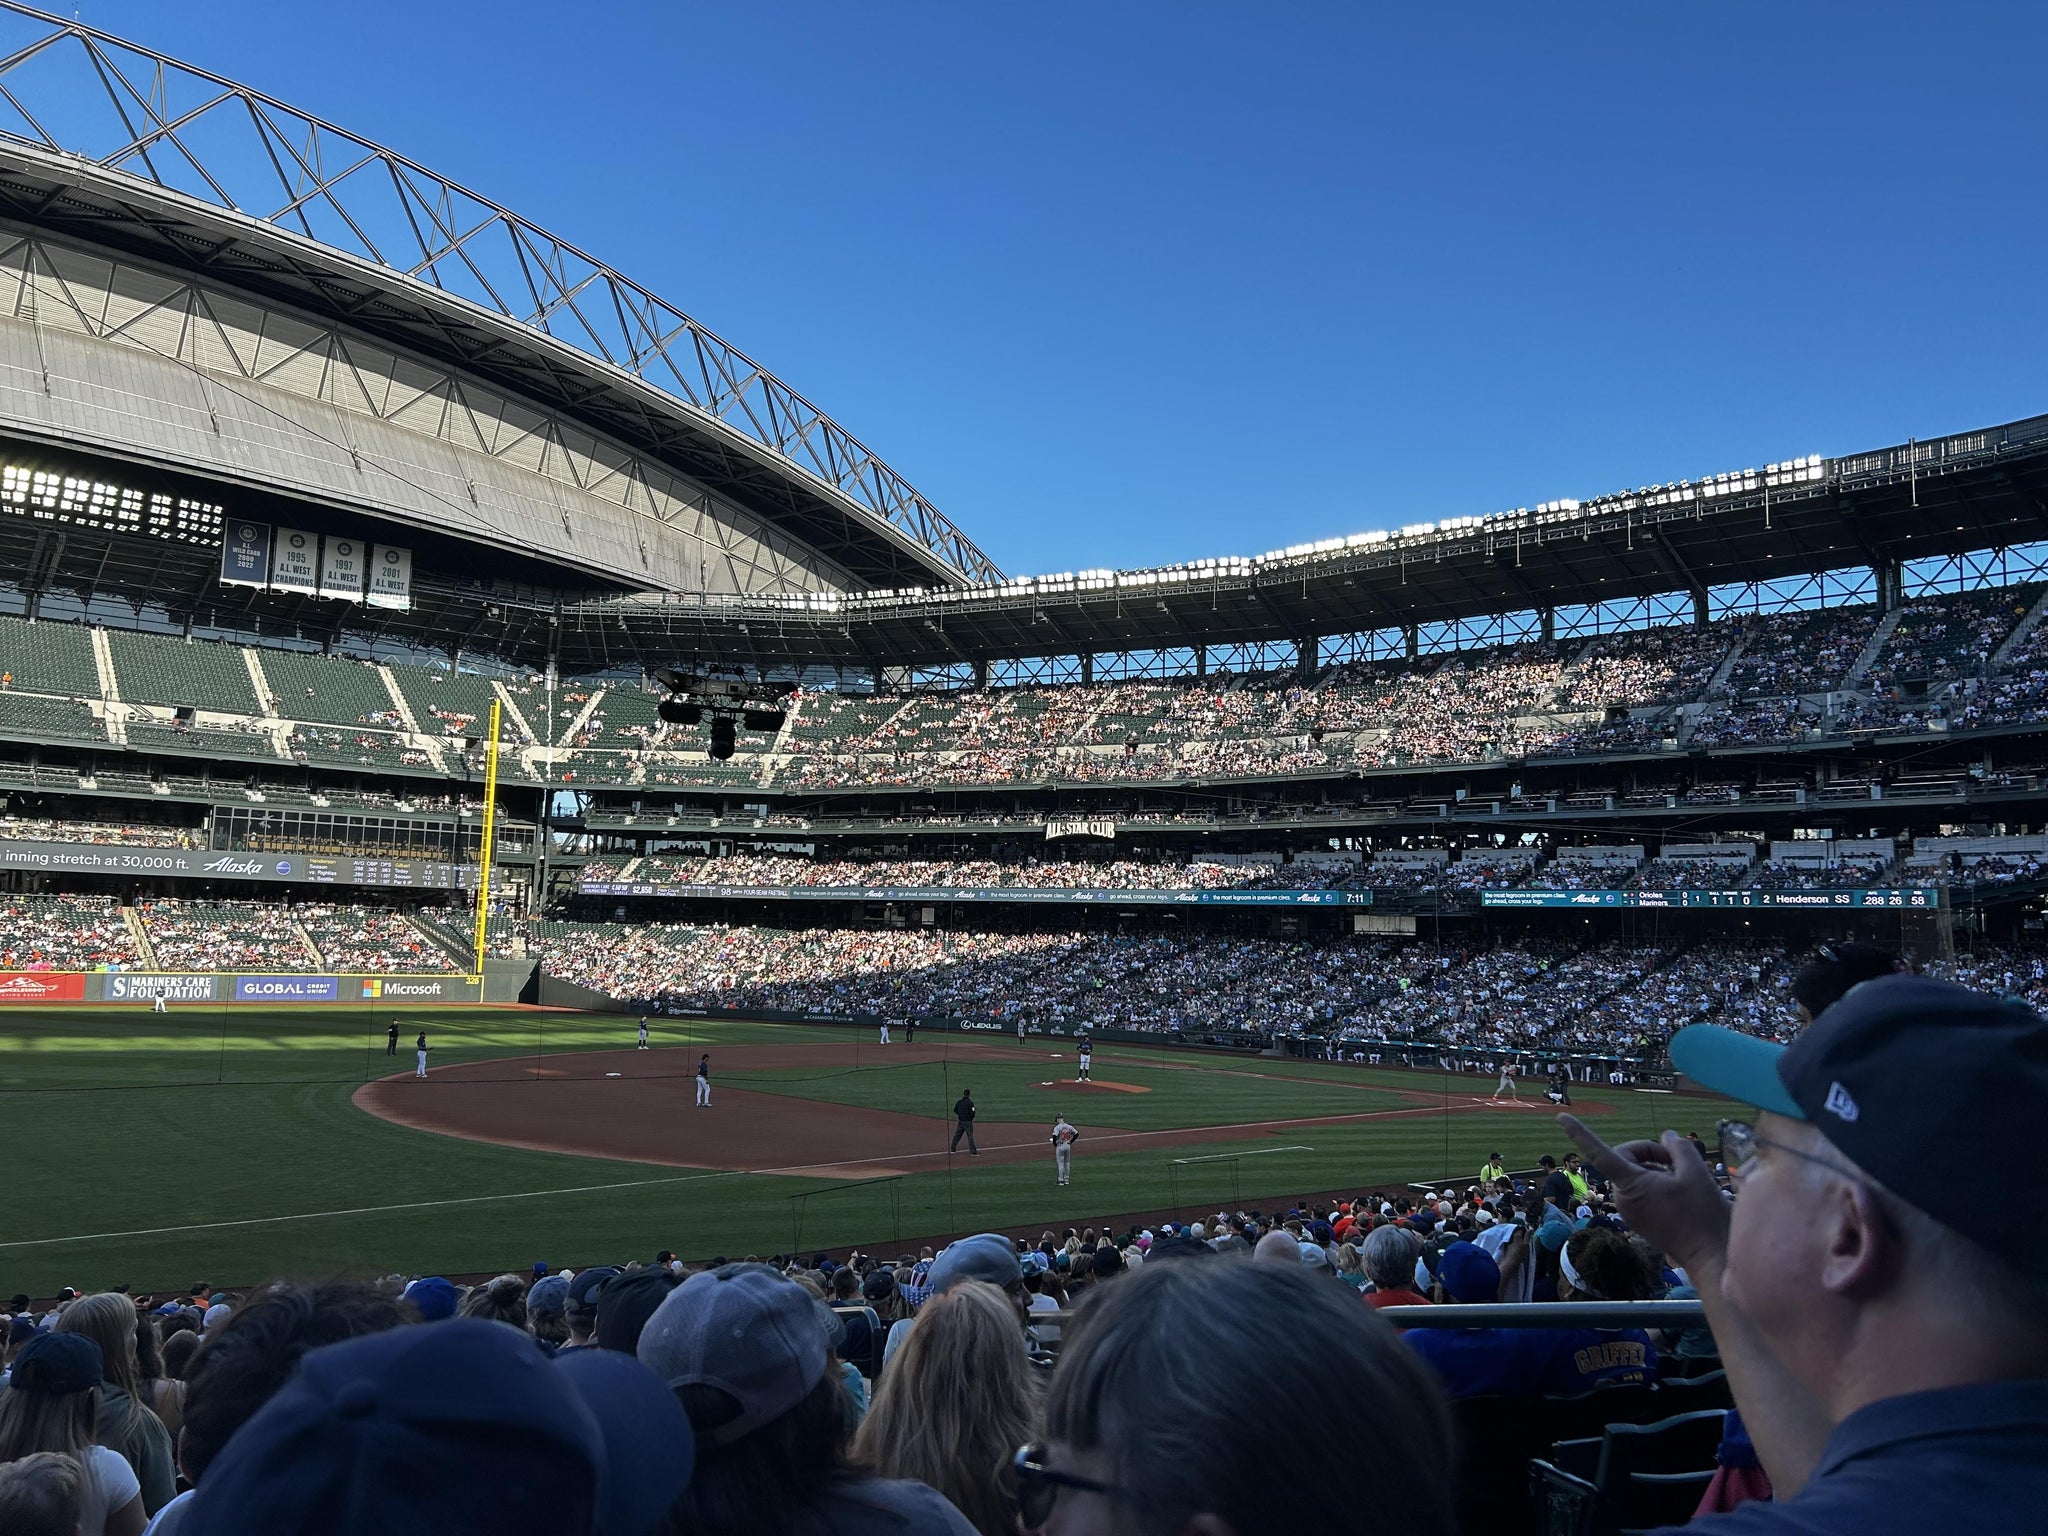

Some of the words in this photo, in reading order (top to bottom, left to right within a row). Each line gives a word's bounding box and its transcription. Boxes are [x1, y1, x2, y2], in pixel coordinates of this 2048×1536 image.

[287, 552, 306, 563] 1995
[237, 560, 254, 568] 2022
[280, 563, 291, 573] A.L.
[293, 565, 311, 575] WEST
[335, 559, 353, 571] 1997
[328, 571, 339, 580] A.L.
[340, 572, 358, 583] WEST
[382, 567, 400, 578] 2001
[275, 574, 313, 587] CHAMPIONS
[376, 578, 386, 587] A.L.
[388, 580, 405, 590] WEST
[324, 581, 361, 593] CHAMPIONS
[1045, 822, 1063, 840] ALL
[1066, 822, 1090, 834] STAR
[1090, 822, 1115, 839] CLUB
[5, 849, 49, 866] inning
[52, 853, 101, 865] stretch
[104, 856, 118, 866] at
[121, 855, 172, 869] 30,000
[176, 858, 189, 869] ft.
[203, 857, 263, 875] Alaska
[721, 888, 731, 896] 98
[954, 891, 976, 899] Alaska
[1070, 892, 1094, 900] Alaska
[1174, 893, 1198, 902] Alaska
[1296, 893, 1321, 903] Alaska
[1346, 894, 1364, 903] 7:11
[1571, 894, 1600, 904] Alaska
[1712, 896, 1717, 905] 1
[1728, 896, 1733, 905] 1
[1743, 896, 1750, 905] 0
[1763, 895, 1770, 903] 2
[1776, 895, 1828, 904] Henderson
[1835, 894, 1850, 903] SS
[1863, 896, 1884, 905] .288
[1889, 896, 1902, 905] 26
[1911, 896, 1925, 905] 58
[131, 977, 182, 987] MARINERS
[186, 977, 212, 987] CARE
[244, 983, 304, 994] GLOBAL
[384, 982, 442, 994] Microsoft
